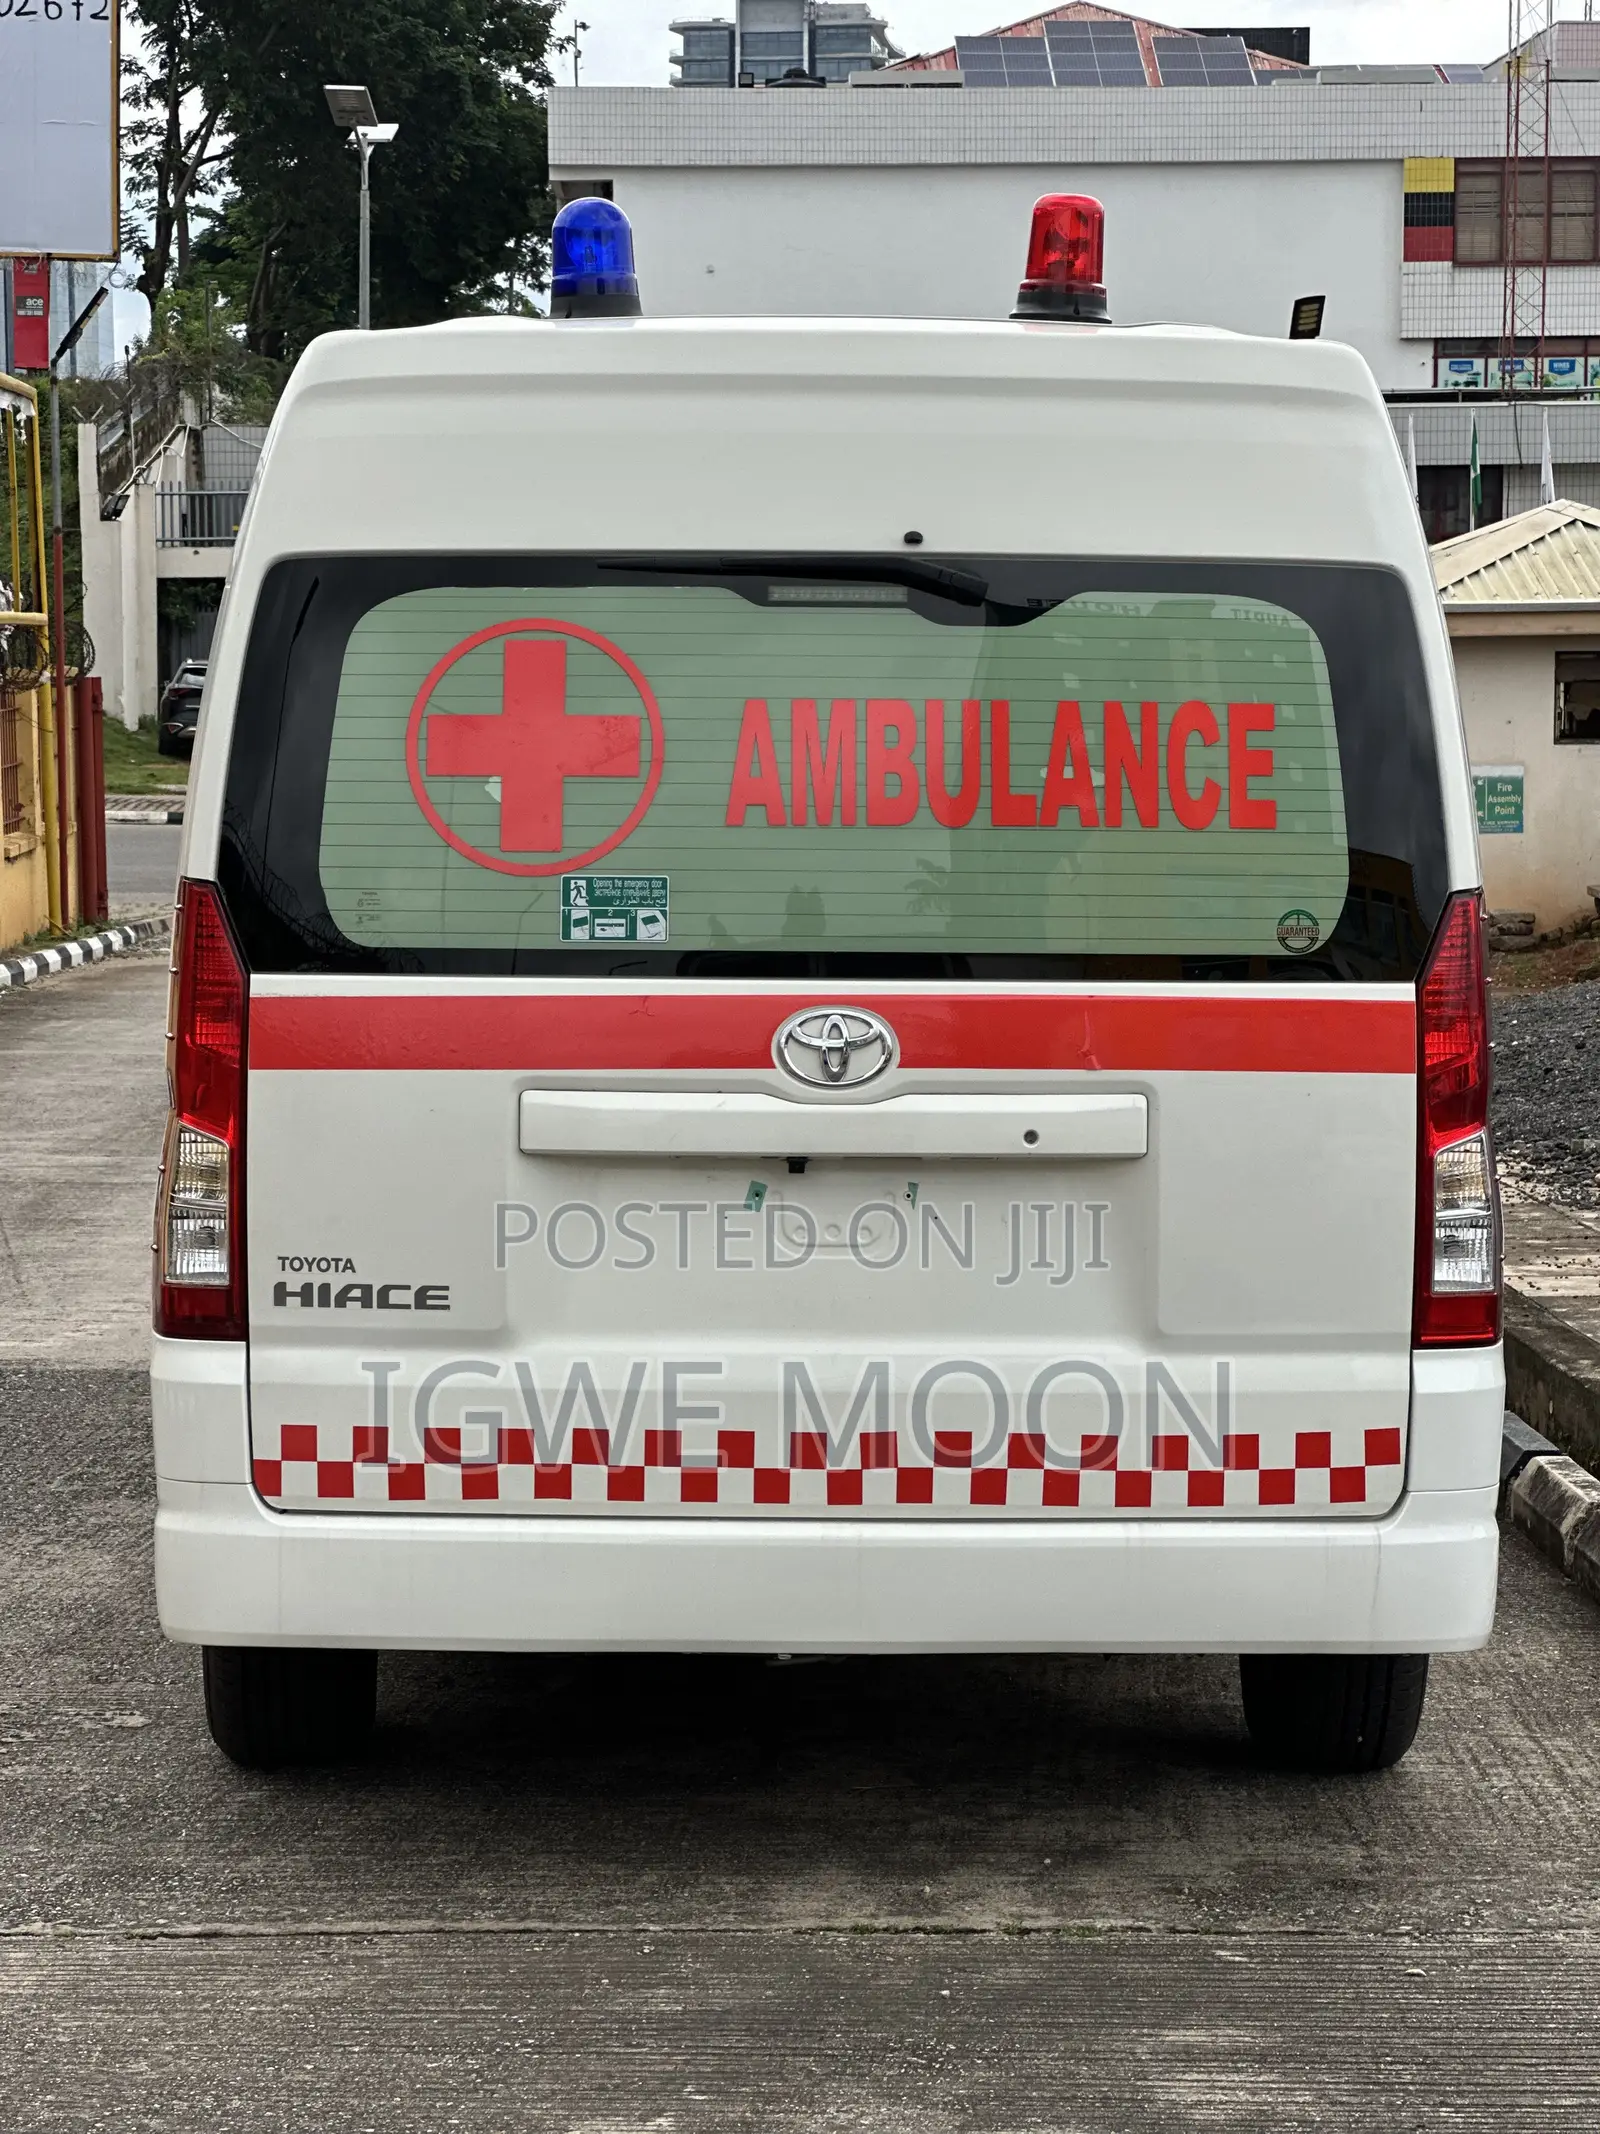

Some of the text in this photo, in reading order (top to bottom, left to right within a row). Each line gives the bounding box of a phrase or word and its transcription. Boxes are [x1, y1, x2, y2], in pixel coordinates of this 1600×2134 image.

[725, 698, 1277, 830] AMBULANCE
[1497, 783, 1513, 792] Fire
[1488, 794, 1521, 805] Assembly
[1494, 805, 1515, 815] Point
[592, 878, 662, 890] Opening the emergency door
[1277, 927, 1319, 936] GUARANTEED
[277, 1256, 356, 1273] TOYOTA
[273, 1281, 451, 1310] HIACE
